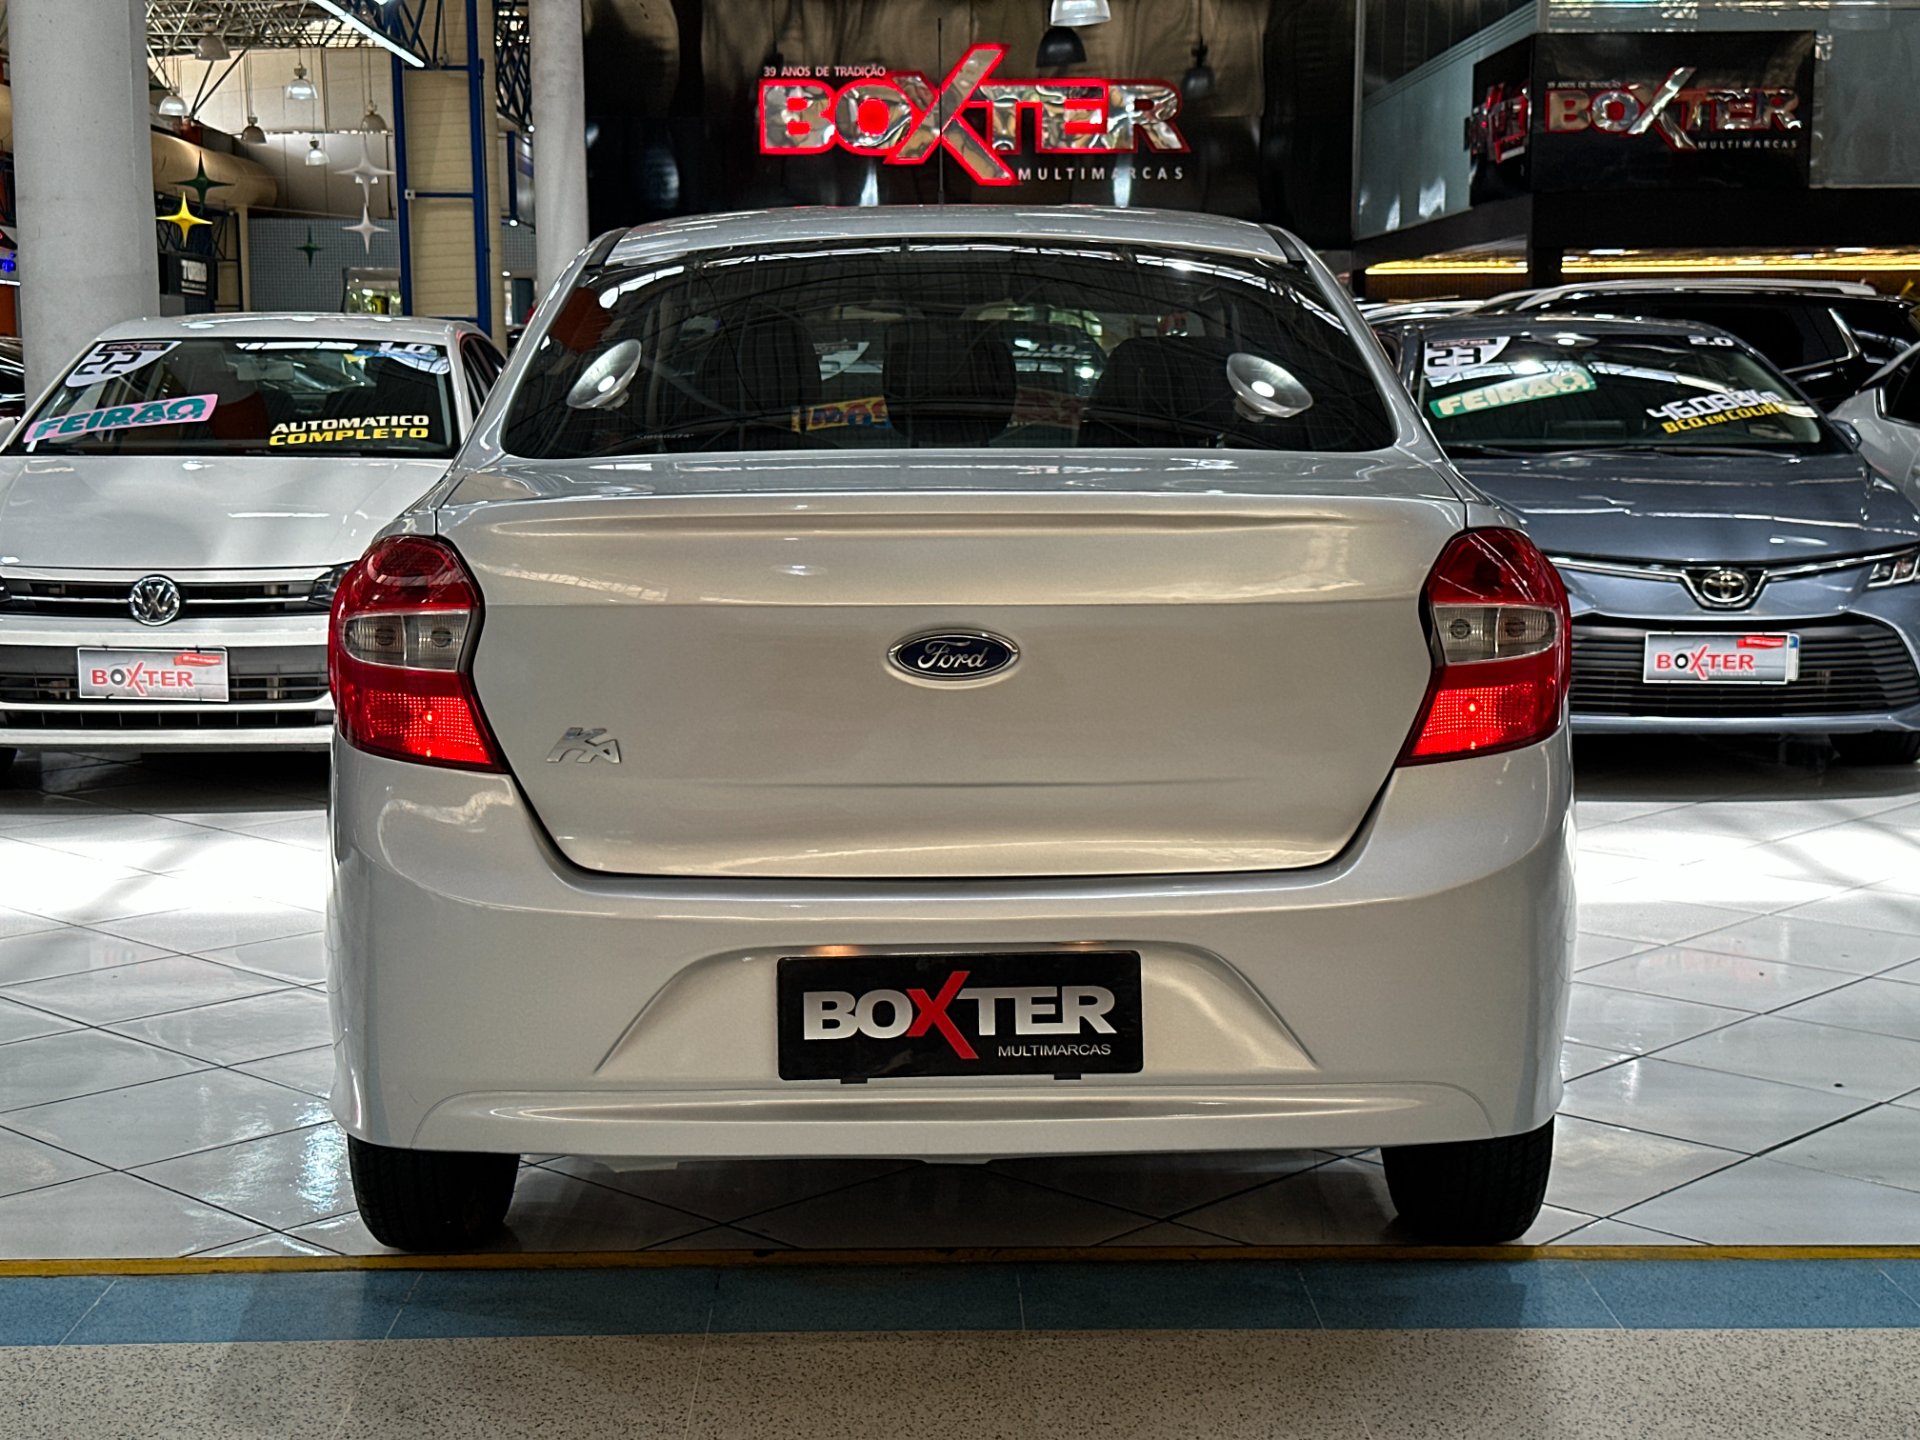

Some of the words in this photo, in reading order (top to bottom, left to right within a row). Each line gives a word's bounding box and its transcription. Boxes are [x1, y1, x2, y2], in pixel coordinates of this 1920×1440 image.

[763, 66, 777, 77] 39
[781, 66, 811, 77] ANOS
[815, 66, 829, 77] DE
[834, 64, 886, 78] TRADIÇÃO
[758, 43, 1190, 186] BOXTER
[1544, 66, 1802, 150] BOXTER
[1698, 140, 1797, 149] MULTIMARCAS
[1018, 167, 1184, 180] MULTIMARCAS
[74, 352, 142, 376] 22
[1427, 347, 1481, 367] 23
[1725, 402, 1789, 421] COUR
[269, 427, 429, 446] COMPLETO
[917, 640, 988, 669] Ford
[1656, 644, 1754, 680] BOXTER
[91, 662, 194, 696] BOXTER
[803, 971, 1117, 1060] BOXTER
[998, 1044, 1111, 1057] MULTIMARCAS
